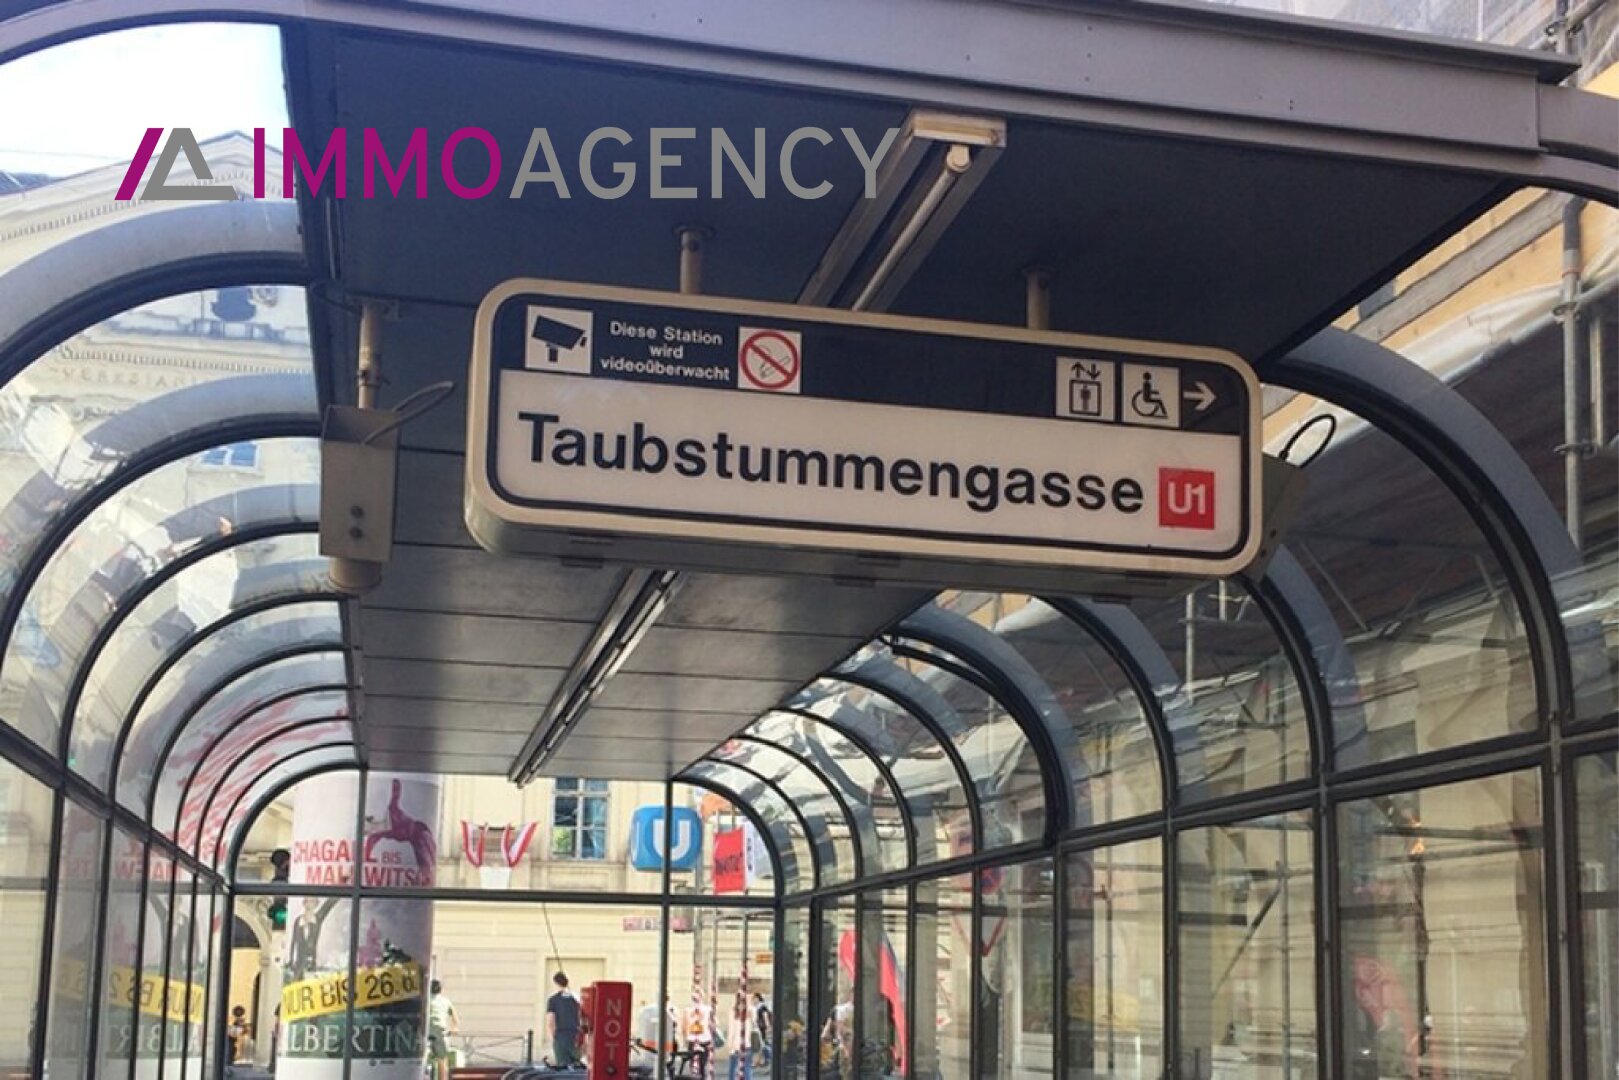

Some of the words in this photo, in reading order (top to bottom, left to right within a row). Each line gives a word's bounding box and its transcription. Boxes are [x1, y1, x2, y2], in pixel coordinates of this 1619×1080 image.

[609, 320, 657, 340] Diese
[663, 325, 724, 347] Station
[600, 355, 731, 382] videoüberwacht
[650, 344, 684, 360] wird
[518, 411, 1145, 514] Taubstummengasse
[1167, 480, 1207, 516] U1
[652, 818, 692, 863] U
[604, 998, 622, 1061] NOT
